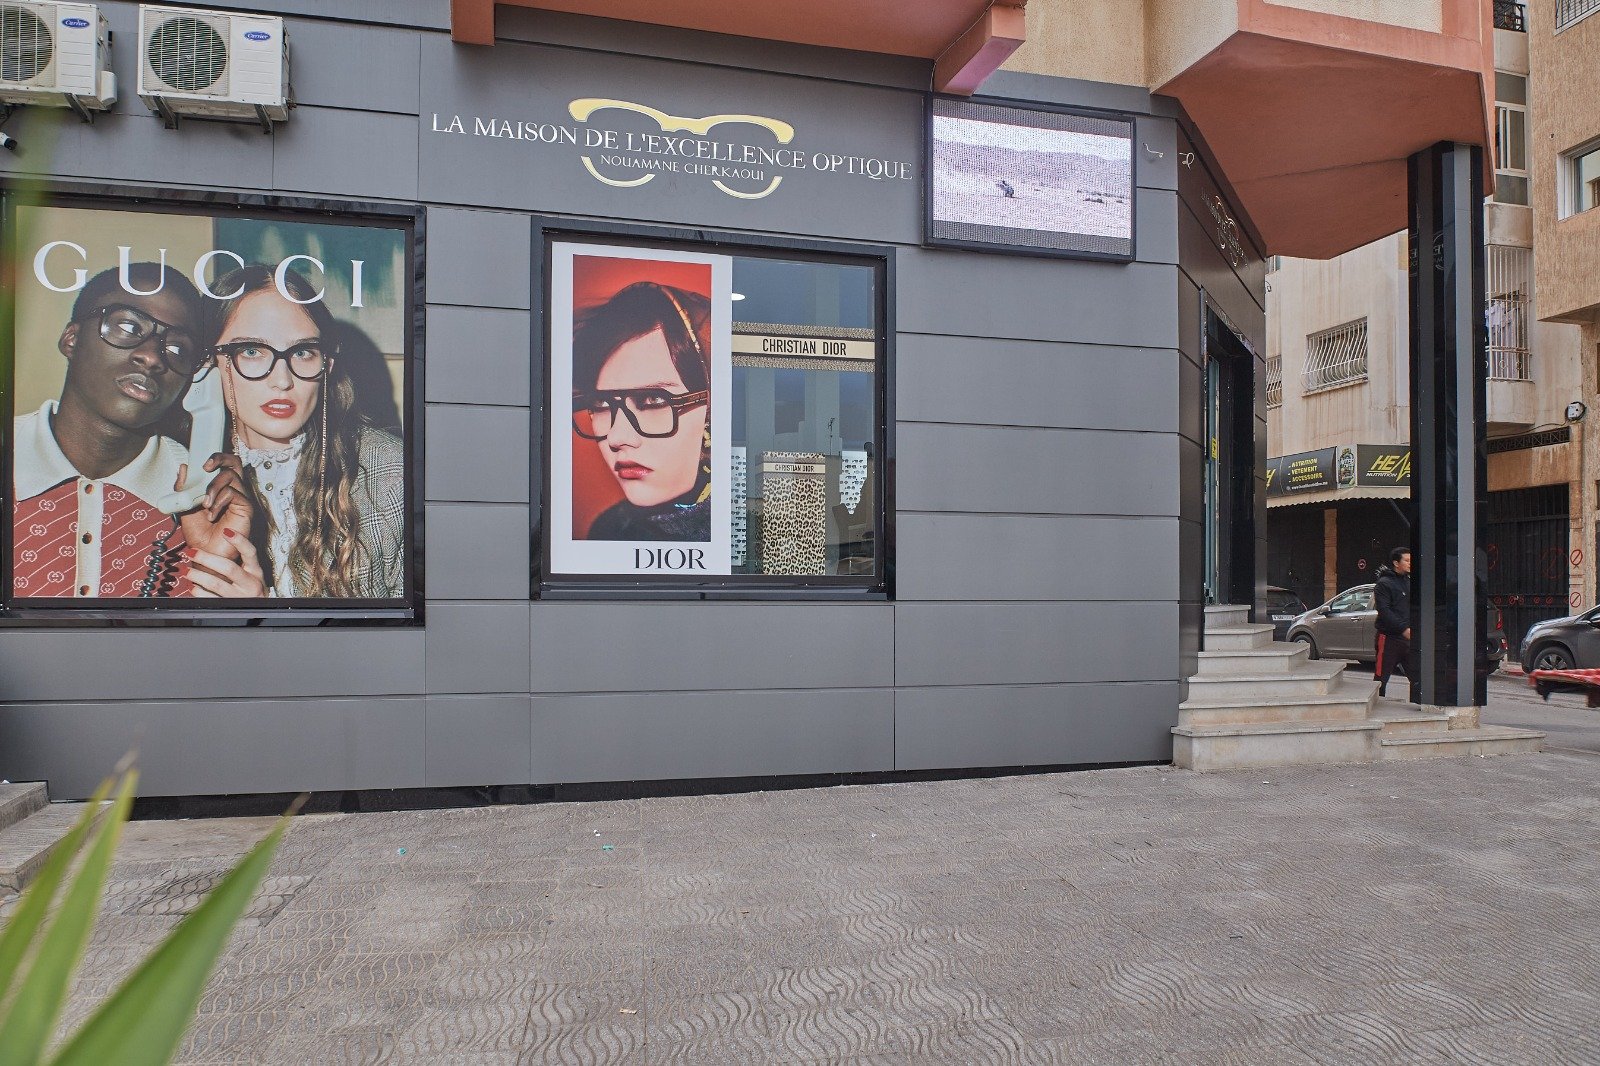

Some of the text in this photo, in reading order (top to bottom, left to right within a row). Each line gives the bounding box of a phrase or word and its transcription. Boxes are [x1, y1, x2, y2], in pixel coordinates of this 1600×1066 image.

[431, 112, 913, 180] LA MAISON DE L'EXCELLENCE OPTIQUE
[600, 155, 764, 181] NOUAMANE CHERKAOUI
[33, 240, 365, 308] GUCCI
[762, 338, 847, 356] CHRISTIAN DIOR
[634, 548, 707, 570] DIOR
